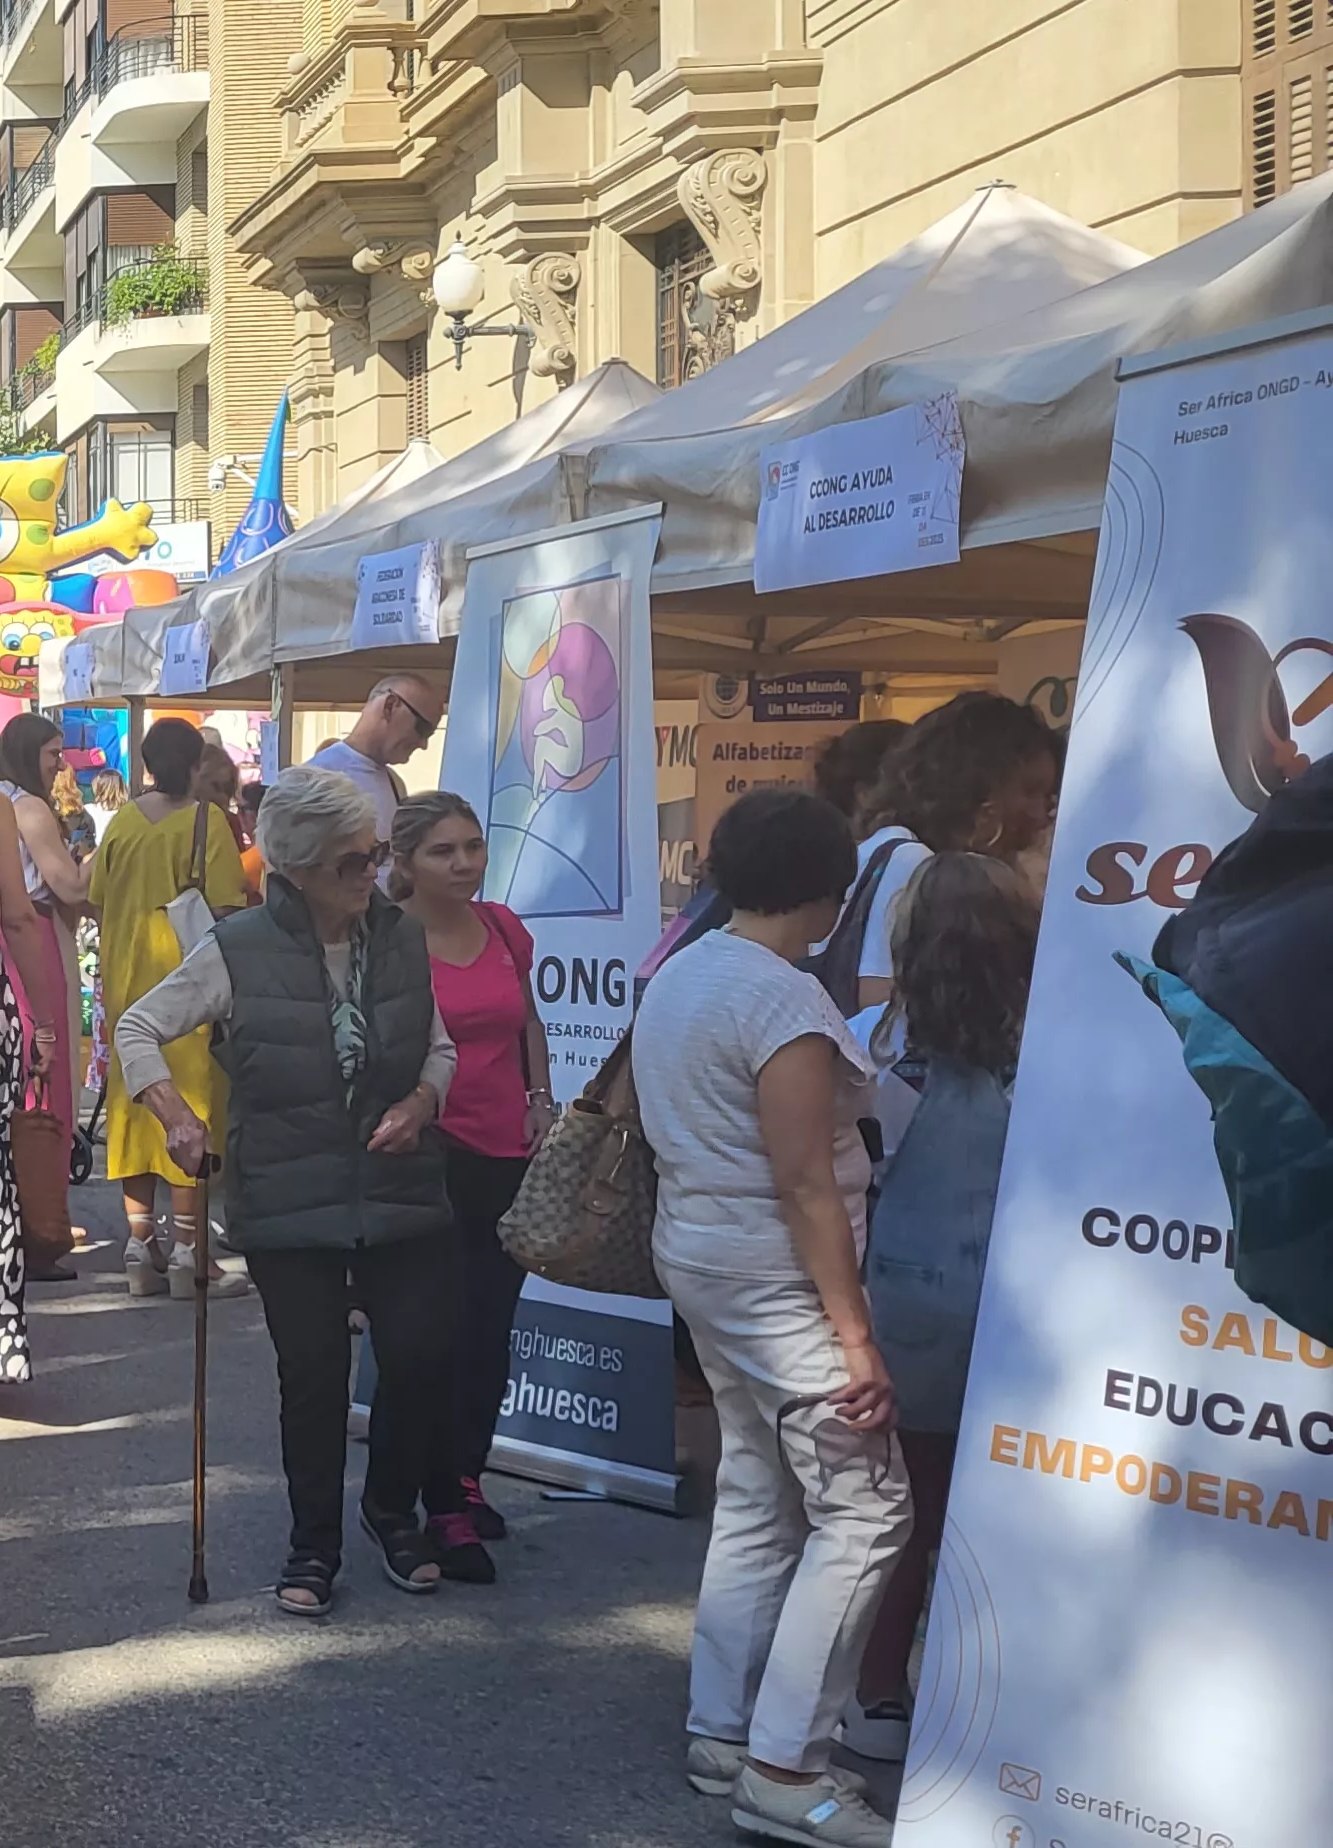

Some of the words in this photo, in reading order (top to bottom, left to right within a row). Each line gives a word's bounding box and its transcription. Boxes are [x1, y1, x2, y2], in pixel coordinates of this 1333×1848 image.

[1178, 400, 1202, 417] Ser
[1206, 390, 1253, 411] Africa
[1257, 376, 1300, 400] ONGD
[1173, 424, 1229, 445] Huesca
[809, 475, 848, 499] CCONG
[850, 465, 894, 493] AYUDA
[804, 515, 817, 535] AL
[818, 500, 895, 532] DESARROLLO
[759, 682, 783, 695] Solo
[787, 682, 803, 694] Un
[806, 680, 851, 695] Mundo,
[767, 703, 783, 716] Un
[786, 701, 844, 717] Mestizaje
[1075, 841, 1212, 908] se
[547, 1022, 627, 1041] ESARROLLO
[549, 1053, 558, 1065] n
[566, 1051, 608, 1067] Hues
[510, 1326, 623, 1372] nghuesca.es
[500, 1372, 620, 1432] ghuesca
